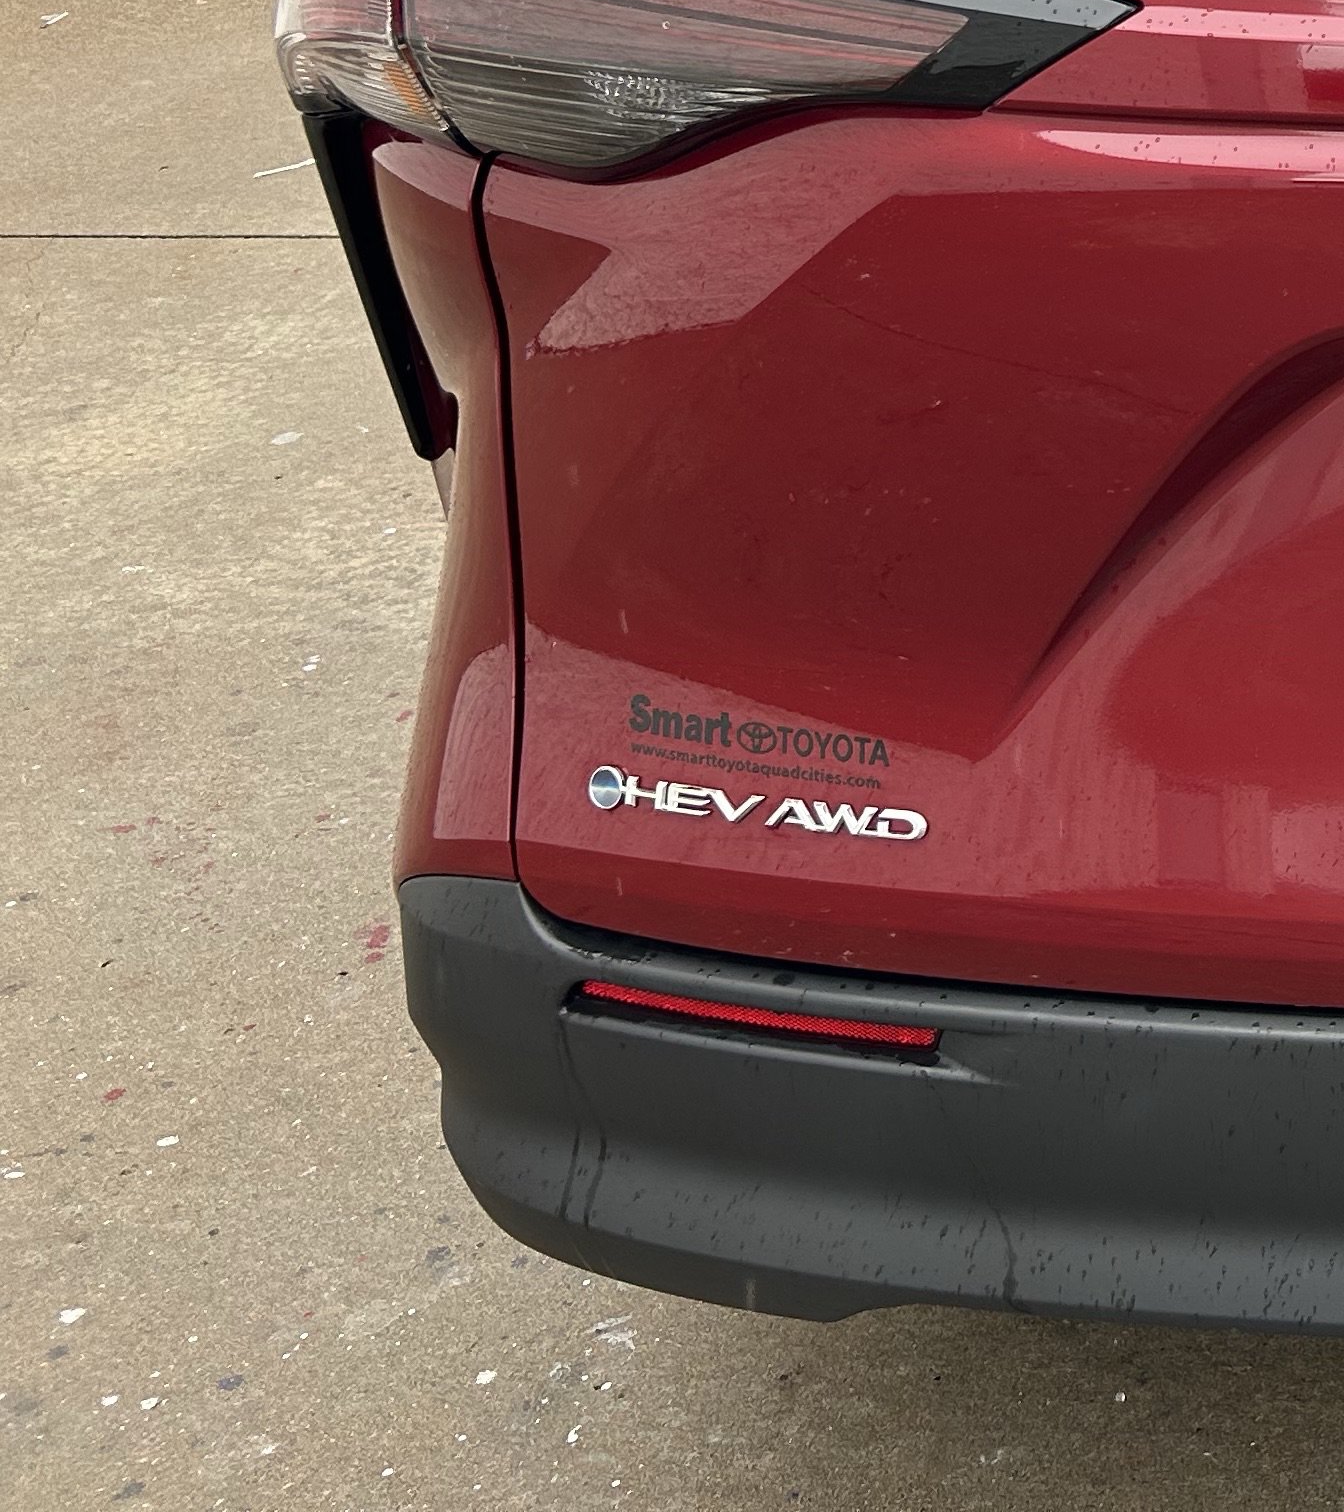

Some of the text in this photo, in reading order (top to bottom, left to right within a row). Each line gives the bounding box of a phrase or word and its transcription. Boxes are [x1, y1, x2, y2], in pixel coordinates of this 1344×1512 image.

[628, 694, 890, 767] Smart TOYOTA
[631, 742, 881, 789] www.smarttoyotaquadcities.com
[764, 797, 928, 841] AWD
